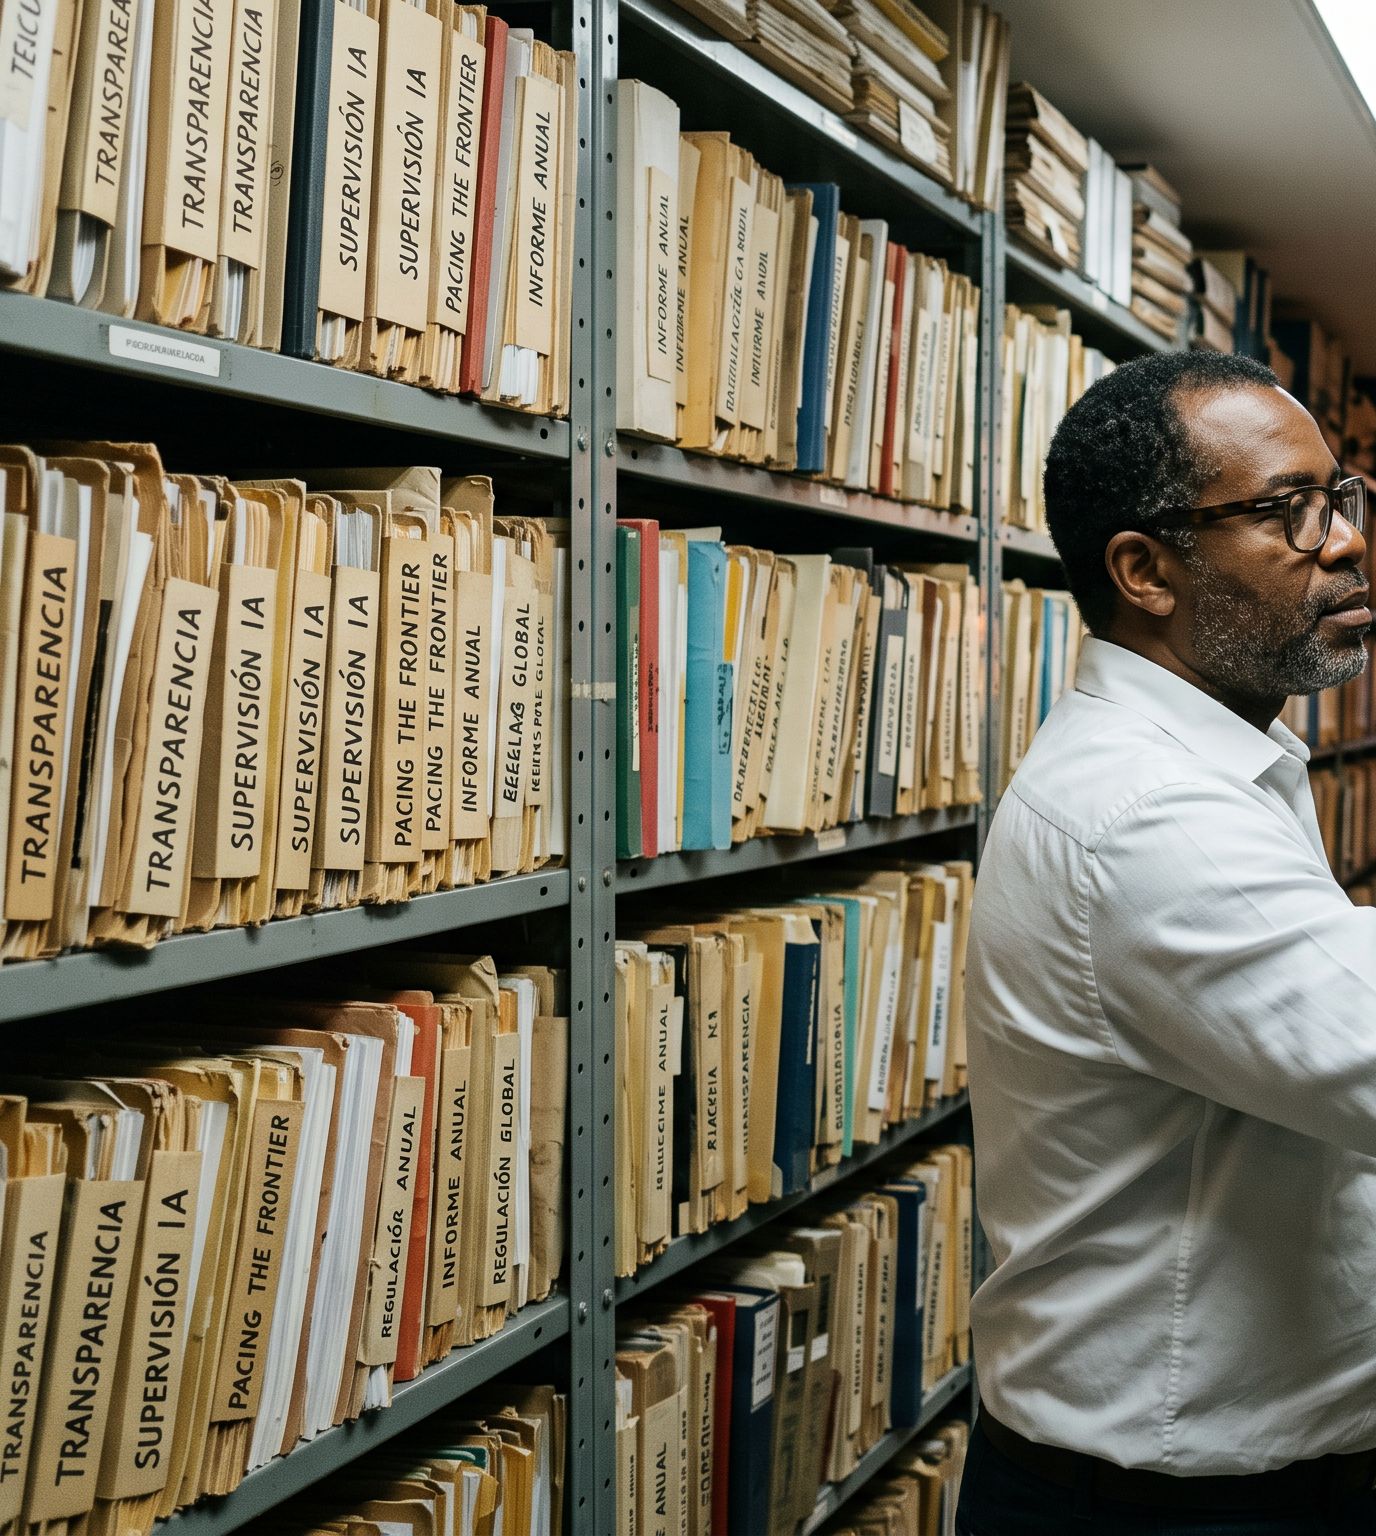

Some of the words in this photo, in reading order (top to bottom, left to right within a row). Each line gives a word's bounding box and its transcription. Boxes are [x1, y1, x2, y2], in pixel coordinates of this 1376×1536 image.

[347, 47, 367, 78] IA
[405, 68, 427, 98] IA
[233, 7, 263, 233] TRANSPARENCIA
[455, 54, 477, 168] FRONTIER
[535, 111, 551, 190] ANUAL
[339, 90, 365, 272] SUPERVISIÓN
[396, 110, 425, 280] SUPERVISIÓN
[451, 173, 471, 218] THE
[445, 229, 466, 314] PACING
[529, 196, 547, 307] INFORME
[679, 215, 689, 276] ANUAL
[658, 264, 668, 355] INFORME
[241, 597, 265, 630] IA
[304, 605, 324, 638] IA
[348, 595, 369, 627] IA
[399, 563, 420, 686] FRONTIER
[430, 553, 448, 673] FRONTIER
[513, 603, 529, 687] GLOBAL
[465, 625, 481, 698] ANUAL
[22, 567, 67, 884] TRANSPARENCIA
[147, 609, 202, 893] TRANSPARENCIA
[231, 649, 262, 852] SUPERVISIÓN
[338, 649, 366, 846] SUPERVISIÓN
[398, 698, 416, 743] THE
[428, 688, 445, 731] THE
[291, 657, 321, 853] SUPERVISIÓN
[426, 746, 443, 831] PACING
[461, 712, 479, 812] INFORME
[395, 759, 414, 847] PACING
[658, 1003, 668, 1071] ANUAL
[451, 1079, 467, 1161] ANUAL
[500, 1058, 516, 1142] GLOBAL
[257, 1114, 289, 1236] FRONTIER
[396, 1105, 416, 1191] ANUAL
[443, 1175, 460, 1289] INFORME
[493, 1156, 511, 1284] REGULACIÓN
[248, 1247, 271, 1297] THE
[0, 1230, 48, 1482] TRANSPARENCIA
[55, 1200, 126, 1487] TRANSPARENCIA
[135, 1252, 181, 1470] SUPERVISIÓN
[158, 1189, 188, 1229] IA
[229, 1309, 262, 1410] PACING
[656, 1442, 667, 1515] ANUAL
